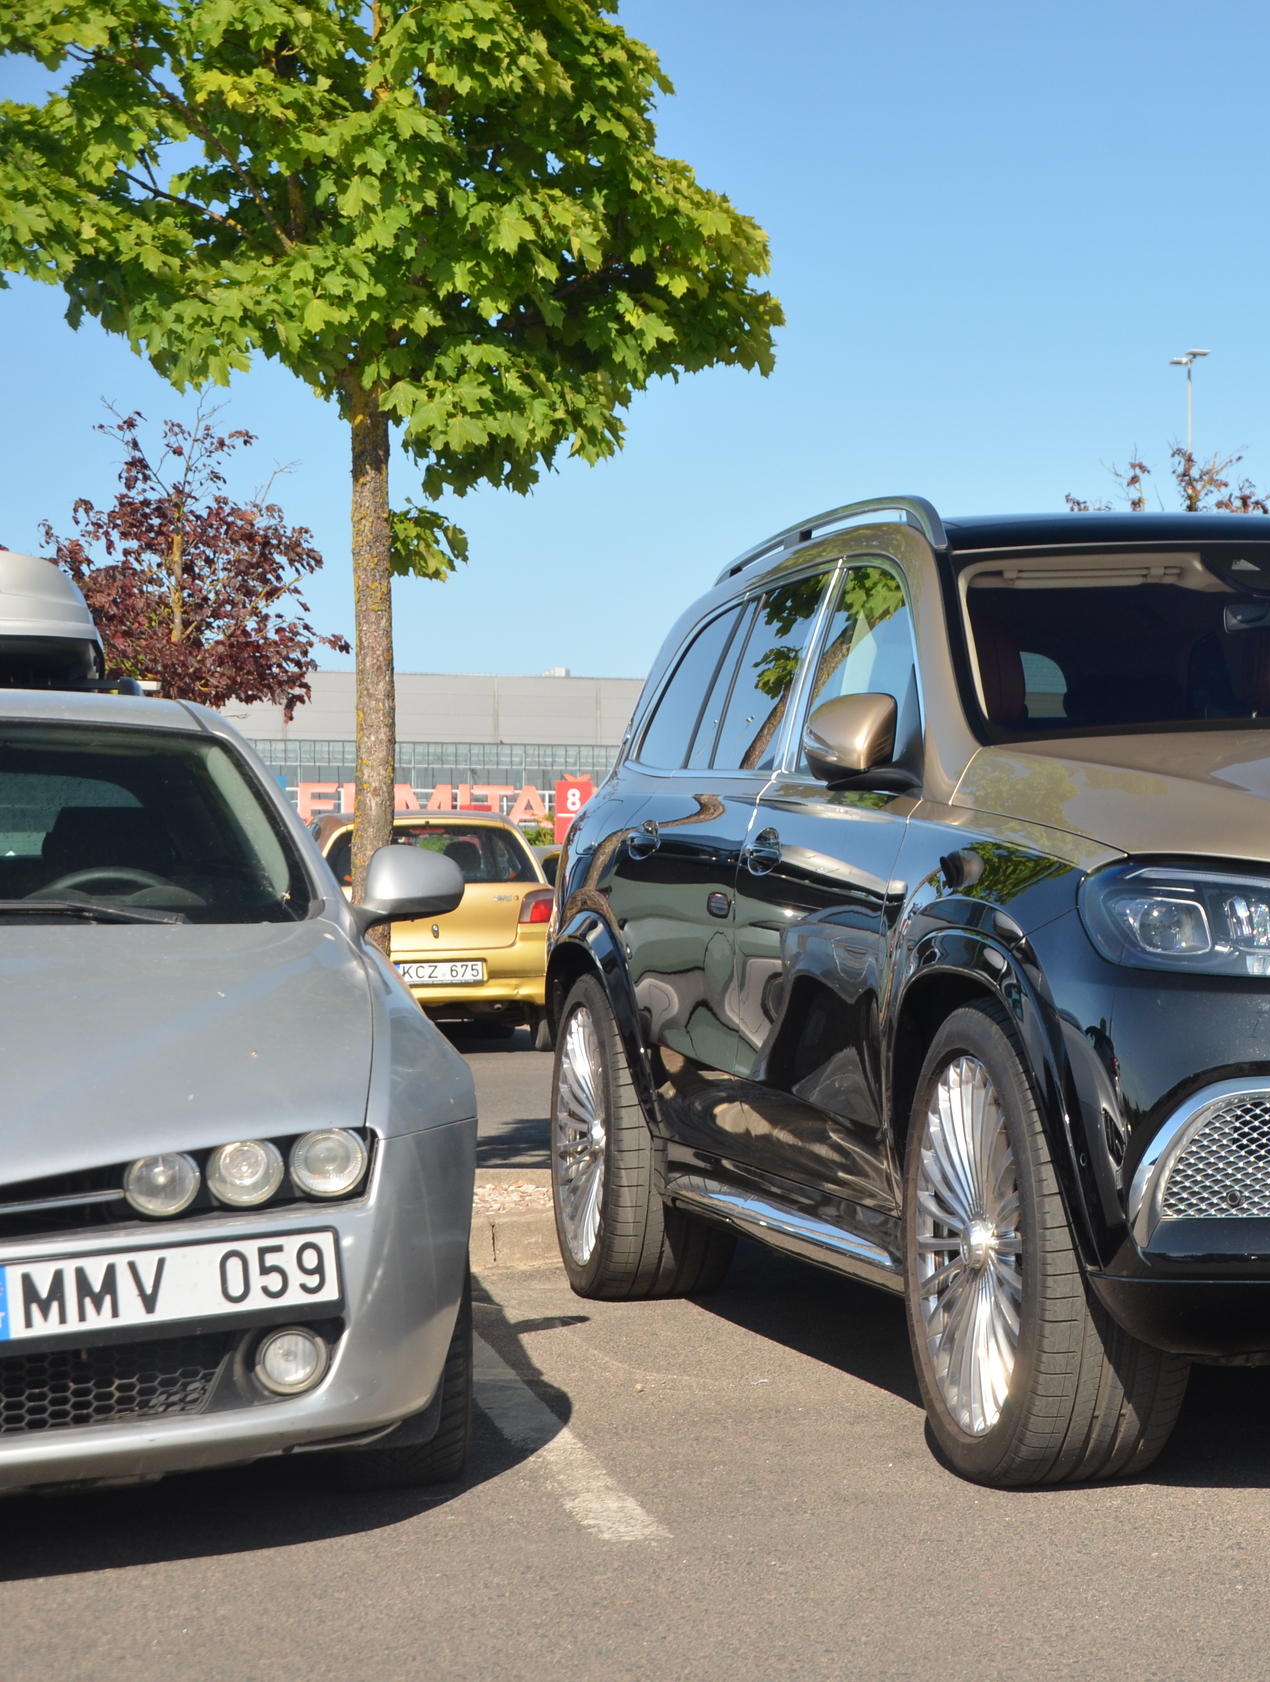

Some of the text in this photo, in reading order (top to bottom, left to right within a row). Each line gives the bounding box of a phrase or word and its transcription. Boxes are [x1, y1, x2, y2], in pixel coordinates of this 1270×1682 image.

[566, 788, 581, 811] 8
[402, 963, 479, 979] KCZ 675
[20, 1241, 326, 1329] MMV 059
